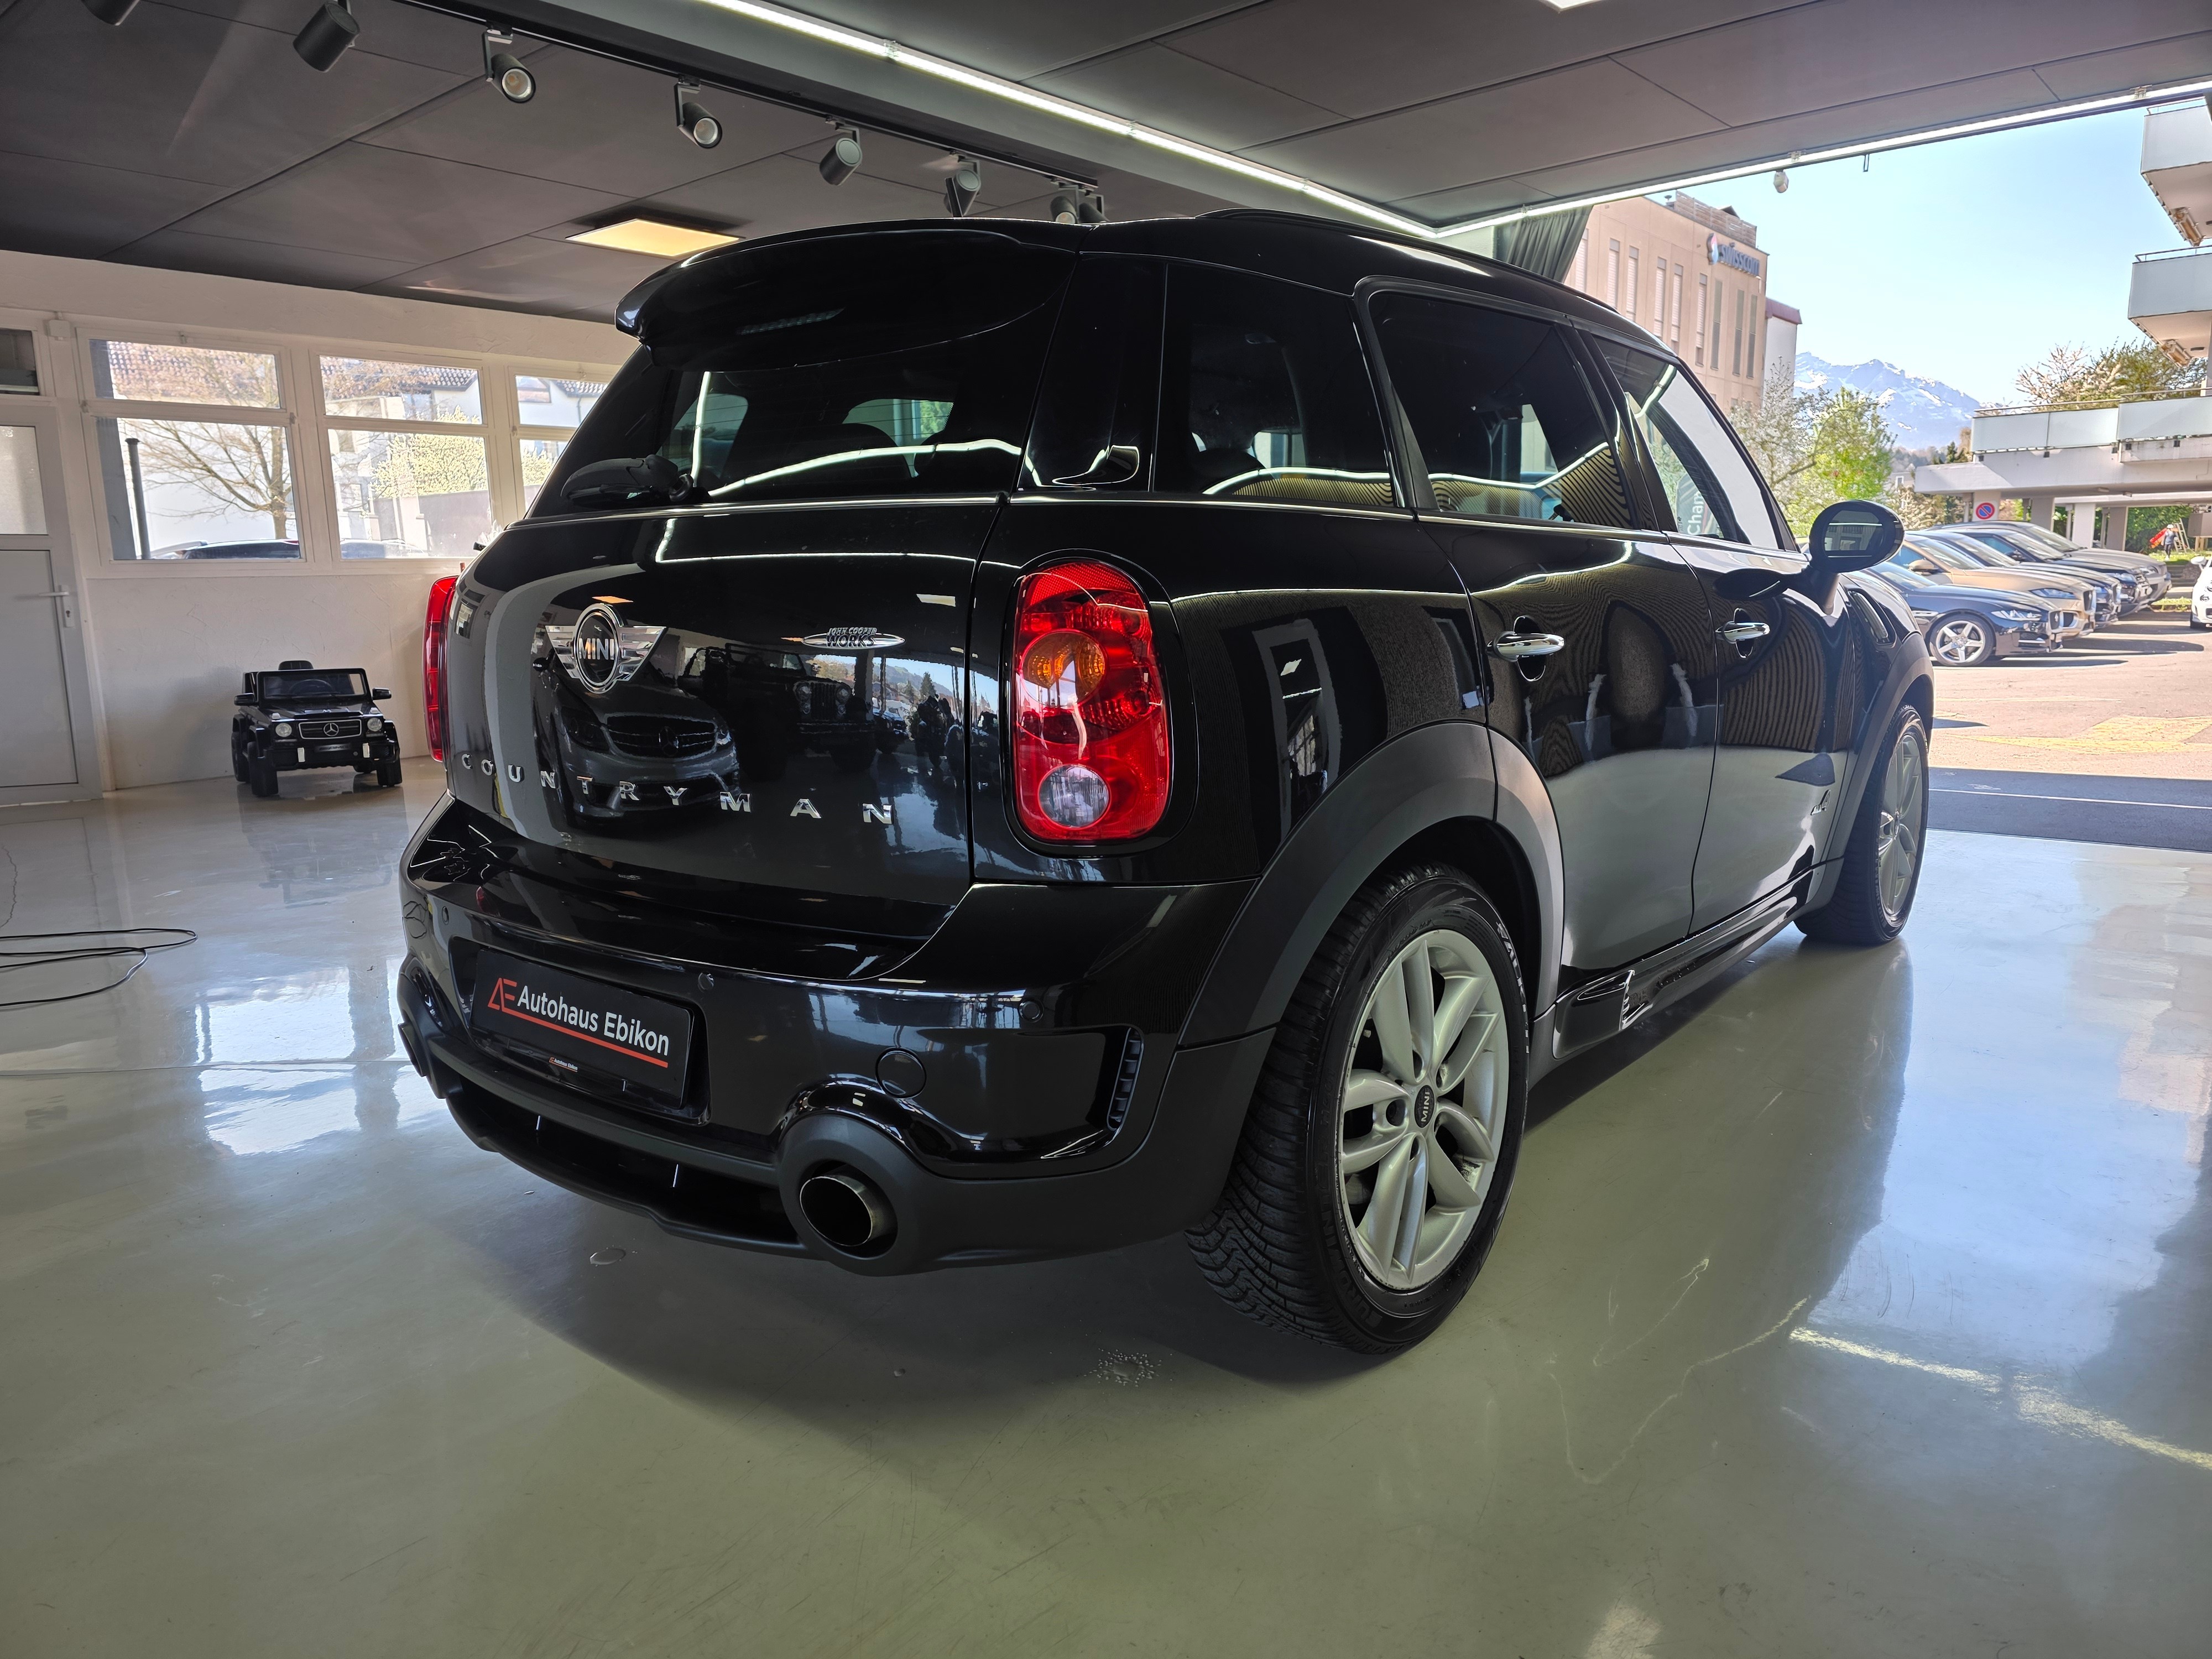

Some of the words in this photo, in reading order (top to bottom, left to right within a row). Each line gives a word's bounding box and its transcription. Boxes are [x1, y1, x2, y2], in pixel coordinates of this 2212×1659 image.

[1721, 242, 1760, 276] swisscom
[826, 634, 875, 647] WORKS
[828, 627, 848, 635] JOHN
[848, 627, 878, 635] COOPER
[578, 638, 614, 660] MINI
[461, 753, 894, 825] COUNTRYMAN
[517, 985, 598, 1032] Autohaus
[603, 1011, 669, 1056] Ebikon
[1421, 1092, 1430, 1122] MINI
